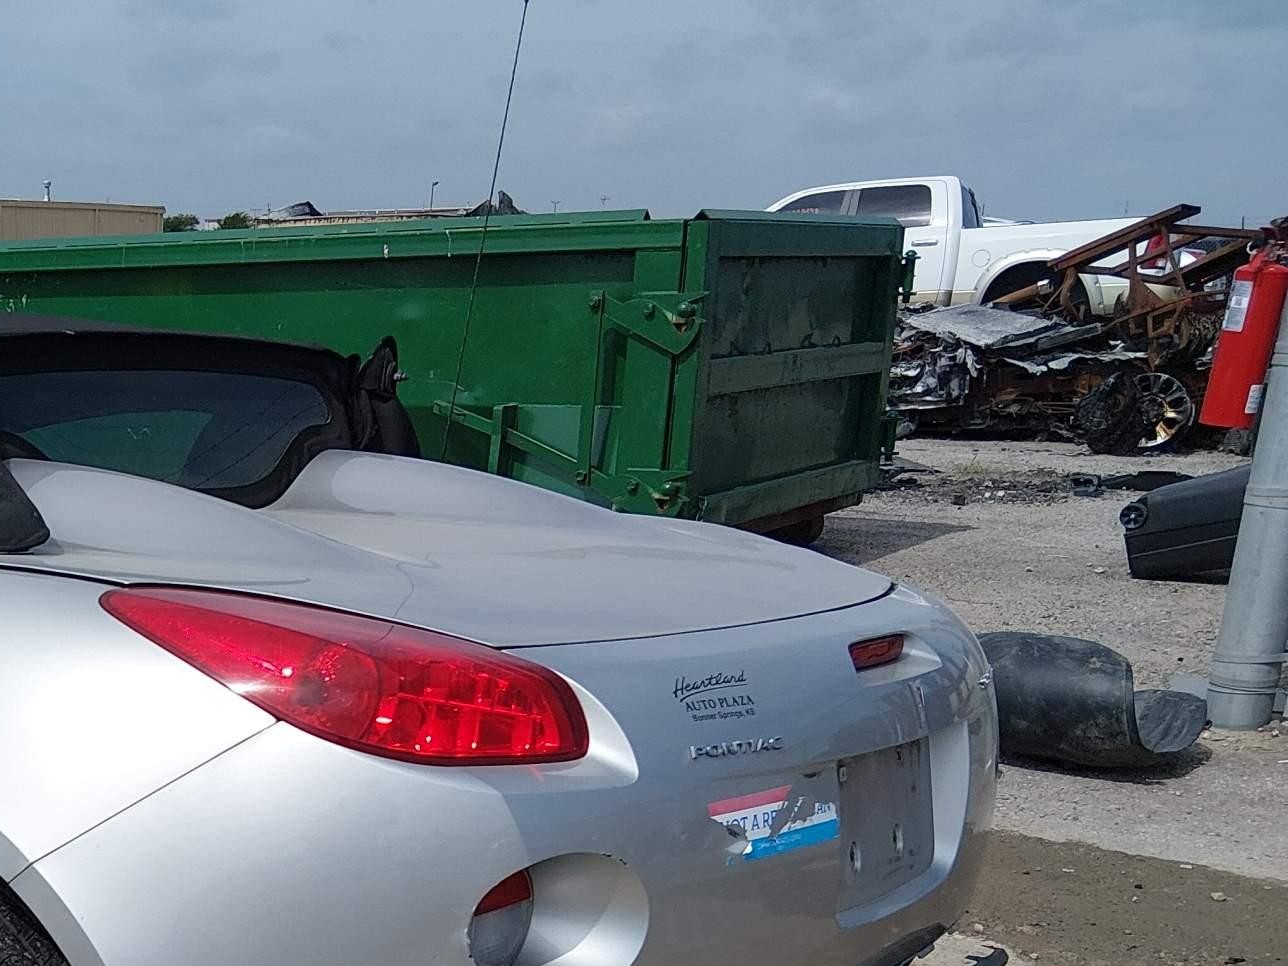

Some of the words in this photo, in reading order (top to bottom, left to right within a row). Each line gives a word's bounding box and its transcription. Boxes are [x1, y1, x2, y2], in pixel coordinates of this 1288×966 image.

[672, 670, 748, 699] Heartland
[685, 699, 717, 713] AUTO
[717, 695, 755, 709] PLAZA
[690, 736, 784, 760] PONTIAC
[751, 814, 761, 831] A
